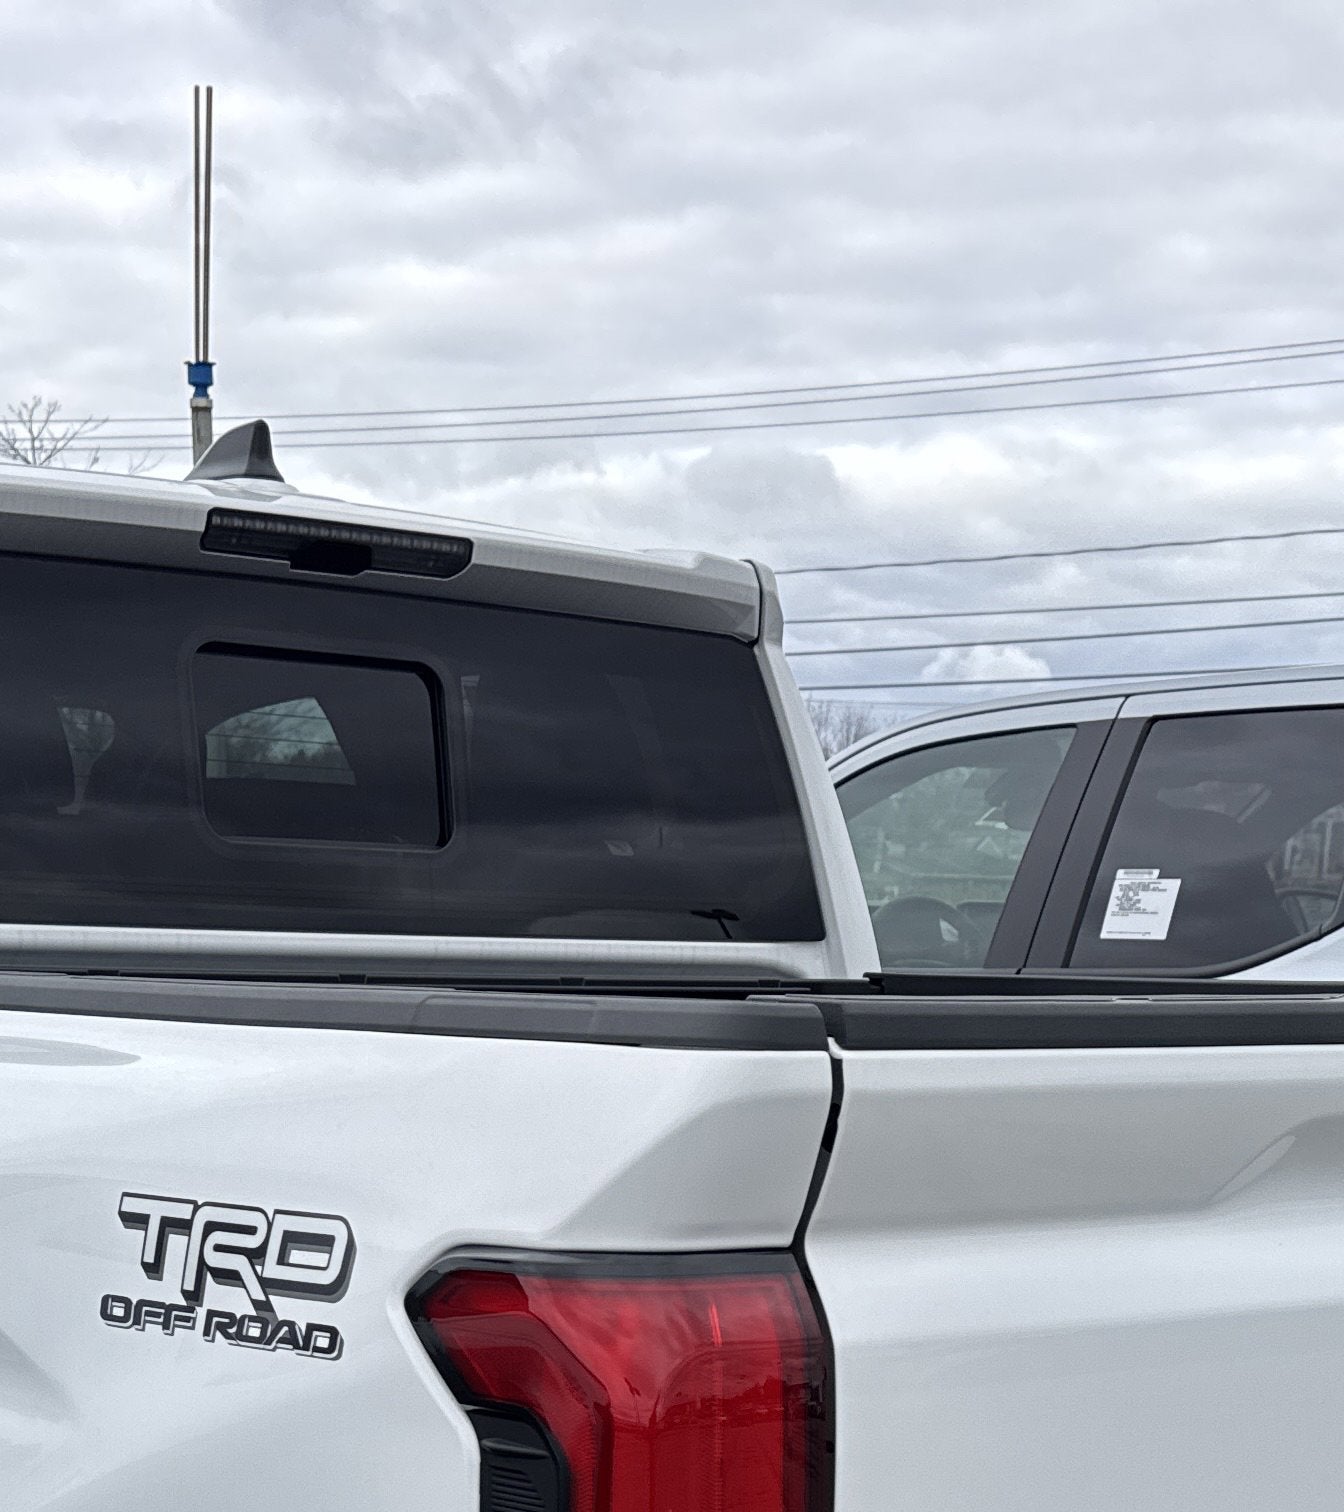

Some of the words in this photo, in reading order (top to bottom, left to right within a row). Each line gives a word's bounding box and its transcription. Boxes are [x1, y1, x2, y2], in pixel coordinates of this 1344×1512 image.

[118, 1191, 357, 1320] TRD
[100, 1294, 198, 1336] OFF
[203, 1308, 344, 1361] ROAD
